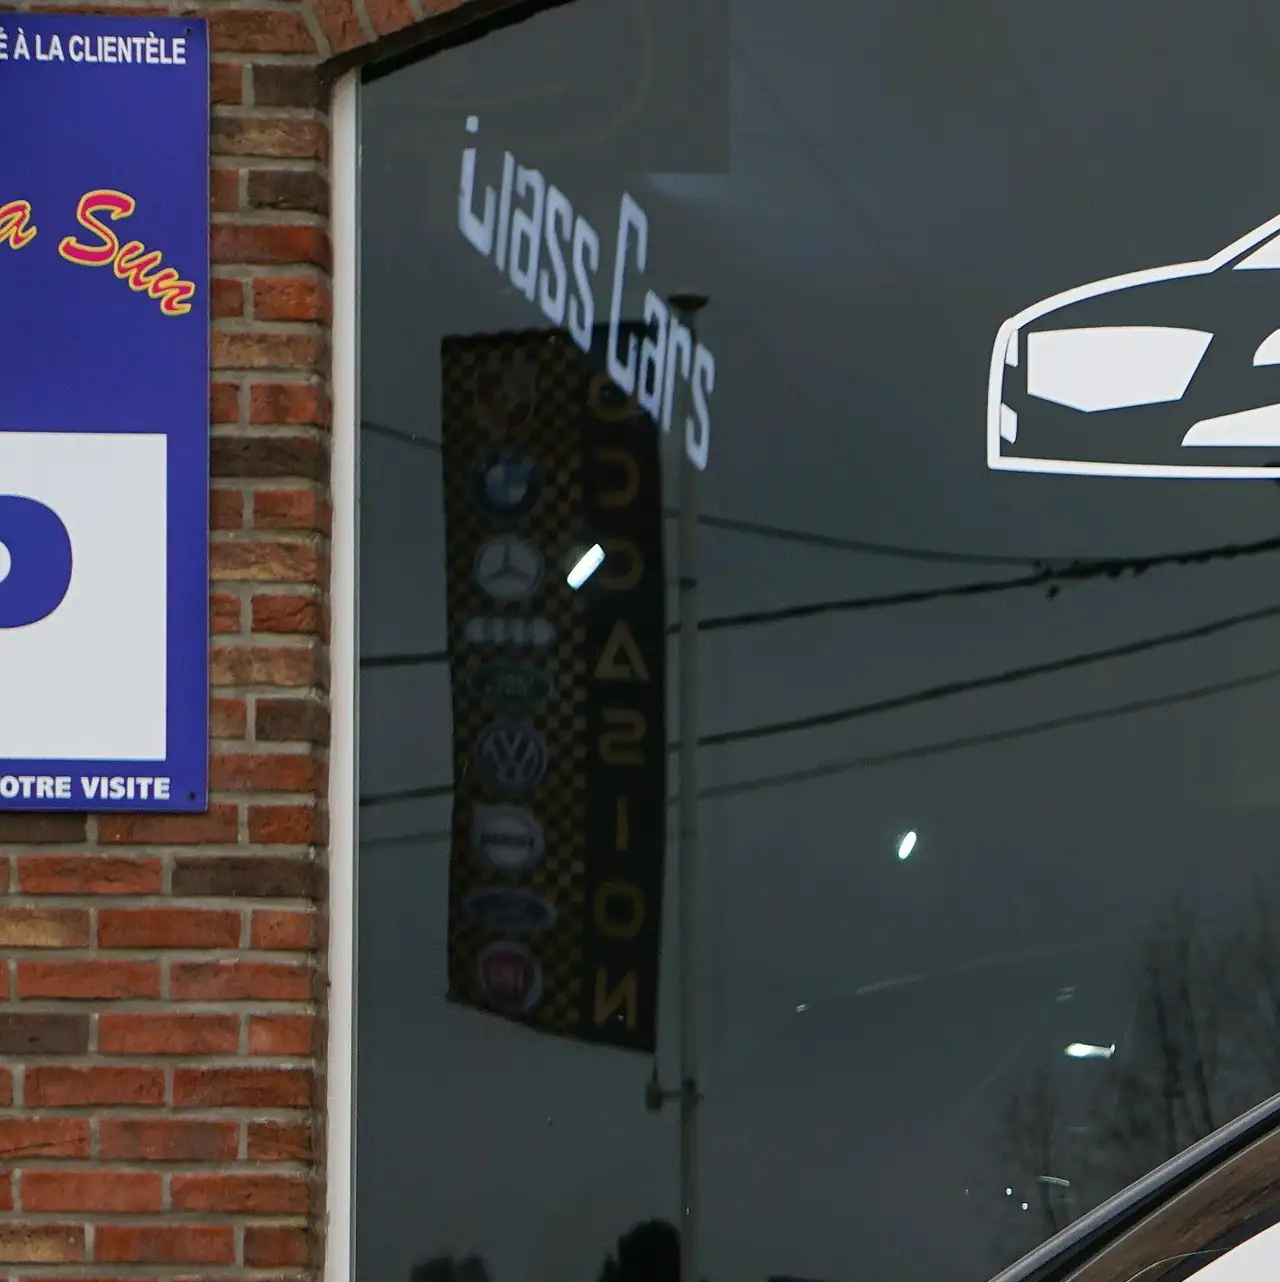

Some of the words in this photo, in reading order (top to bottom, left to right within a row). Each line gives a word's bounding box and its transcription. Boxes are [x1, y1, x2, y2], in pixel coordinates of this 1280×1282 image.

[13, 26, 31, 60] À
[35, 34, 65, 61] LA
[69, 31, 187, 65] CLIENTÈLE
[58, 188, 196, 316] Sun
[607, 190, 716, 472] Cars
[80, 776, 171, 800] VISITE
